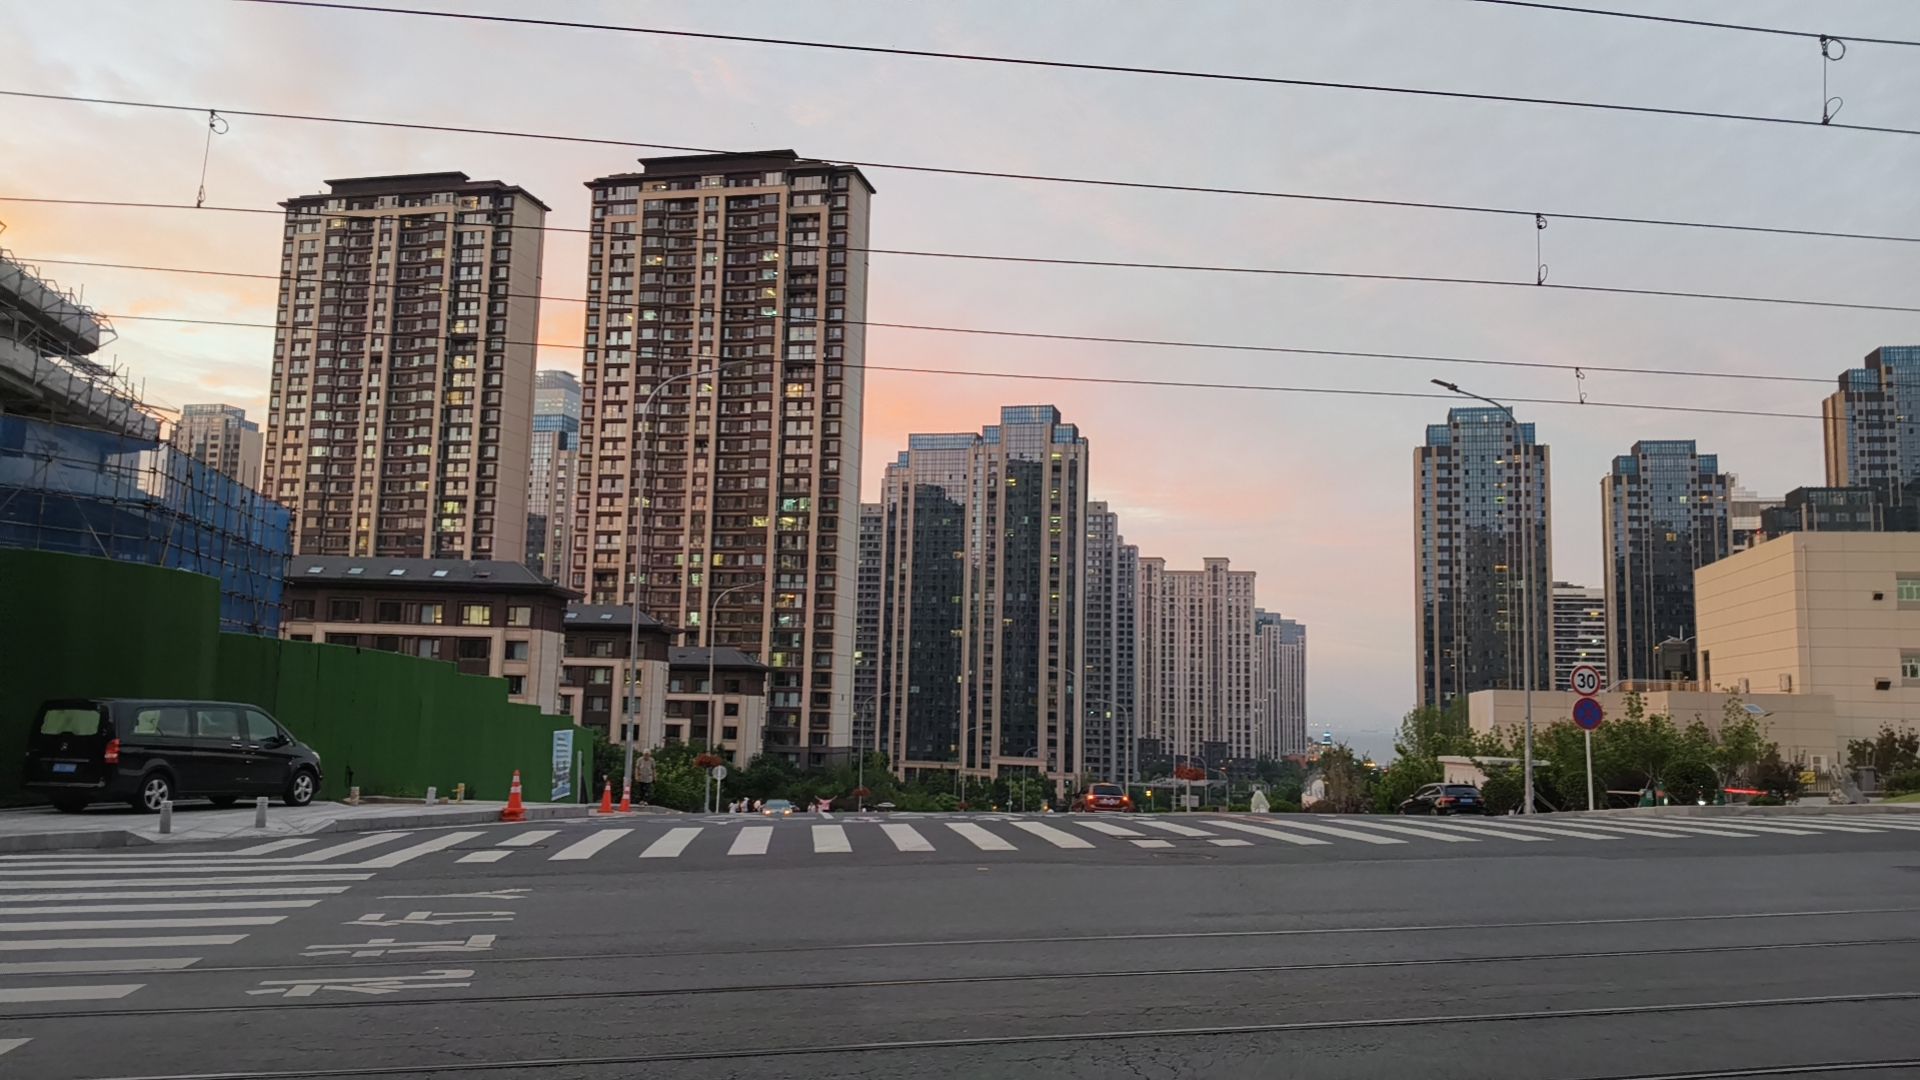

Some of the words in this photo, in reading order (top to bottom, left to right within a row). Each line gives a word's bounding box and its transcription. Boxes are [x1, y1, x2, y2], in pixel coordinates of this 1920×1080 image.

[1577, 673, 1596, 689] 30
[245, 888, 533, 998] 礼让行人
